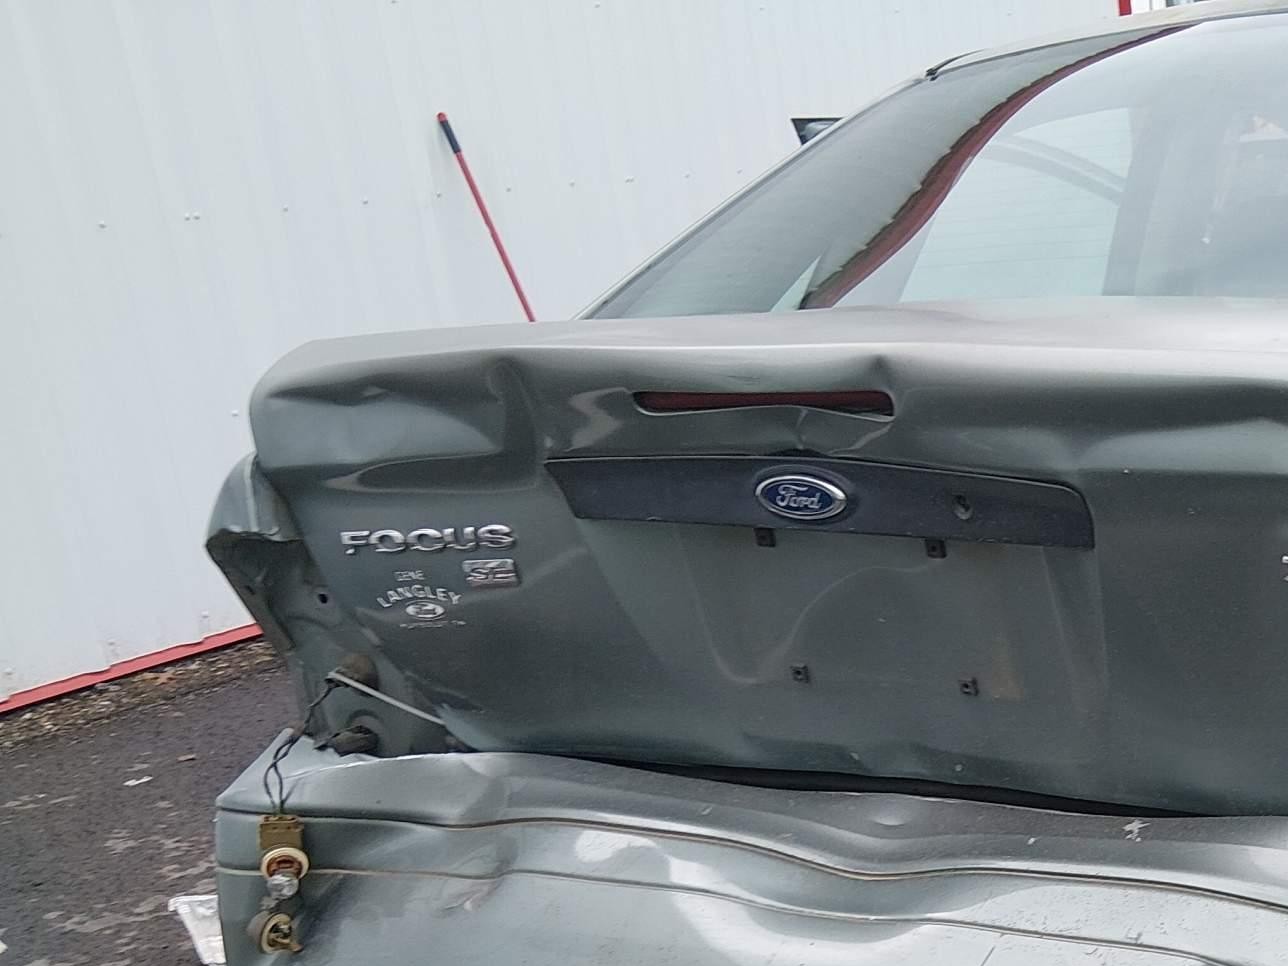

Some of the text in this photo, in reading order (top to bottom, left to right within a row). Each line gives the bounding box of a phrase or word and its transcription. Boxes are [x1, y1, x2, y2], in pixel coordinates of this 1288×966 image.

[776, 484, 822, 508] Ford
[339, 524, 515, 554] FOCUS
[376, 584, 462, 608] LANGLEY
